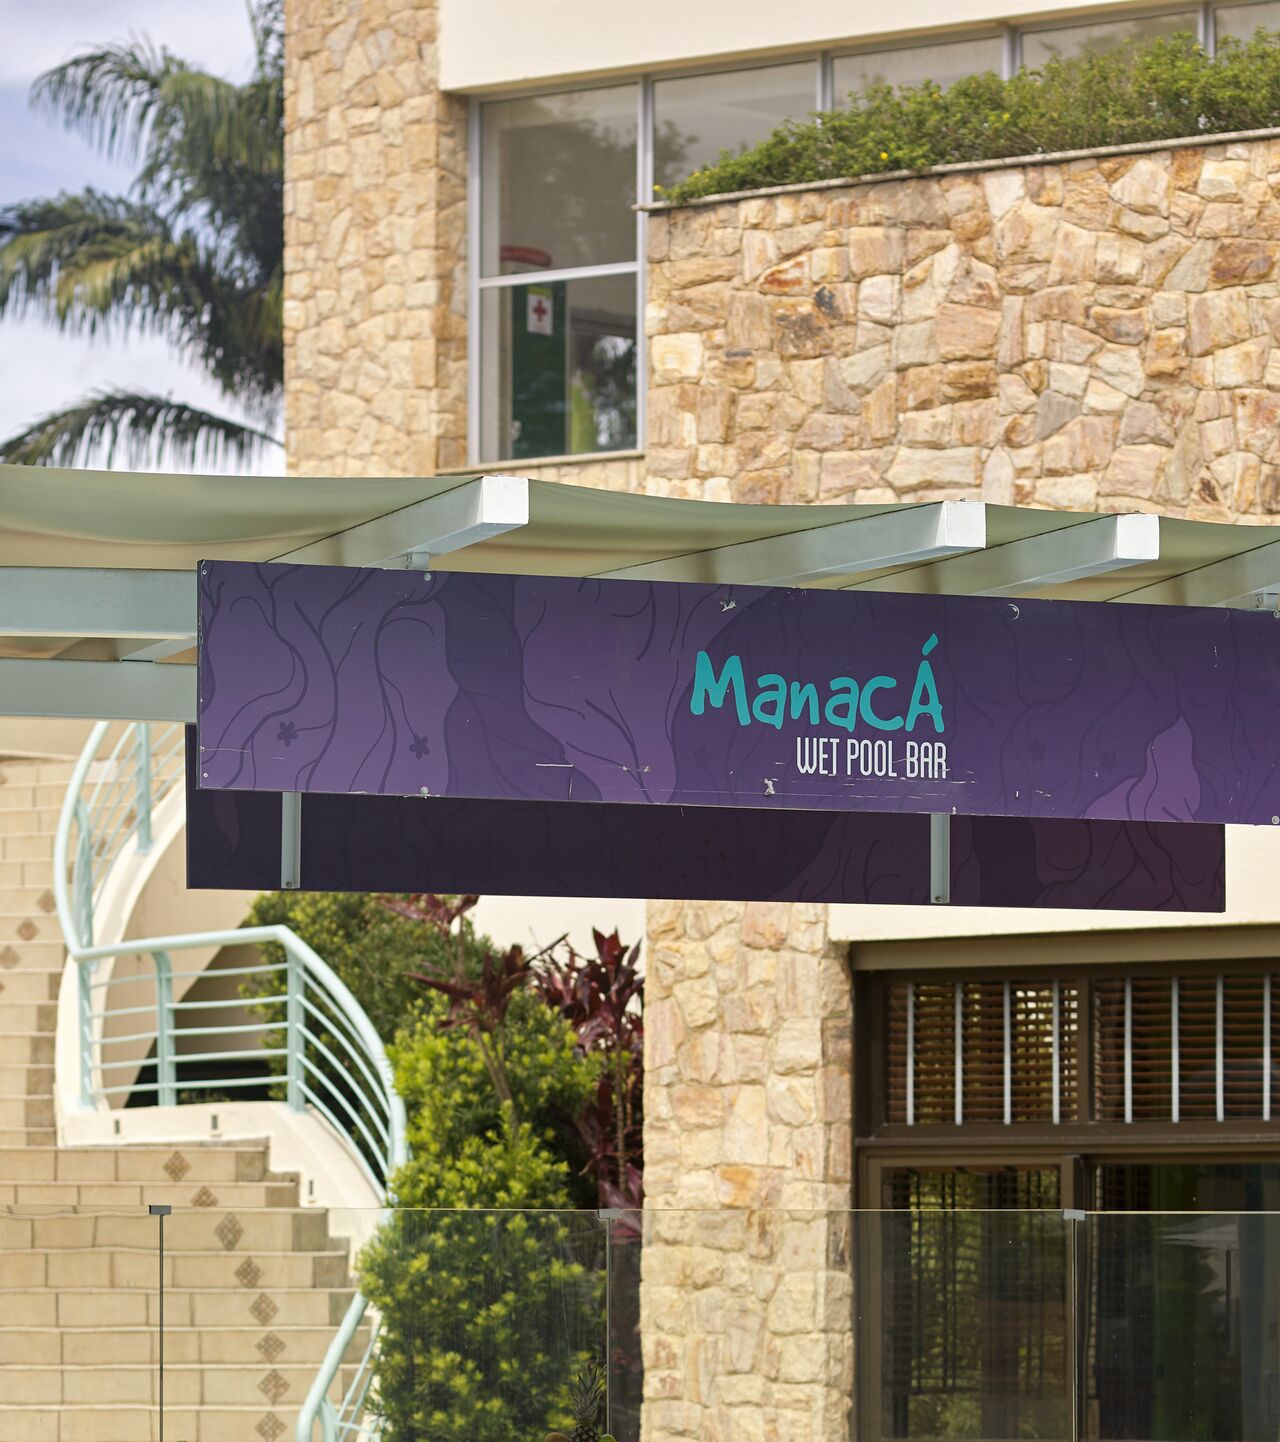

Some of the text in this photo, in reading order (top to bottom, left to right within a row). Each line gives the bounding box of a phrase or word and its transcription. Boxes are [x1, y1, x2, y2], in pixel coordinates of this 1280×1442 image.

[796, 736, 948, 779] WET POOL BAR
